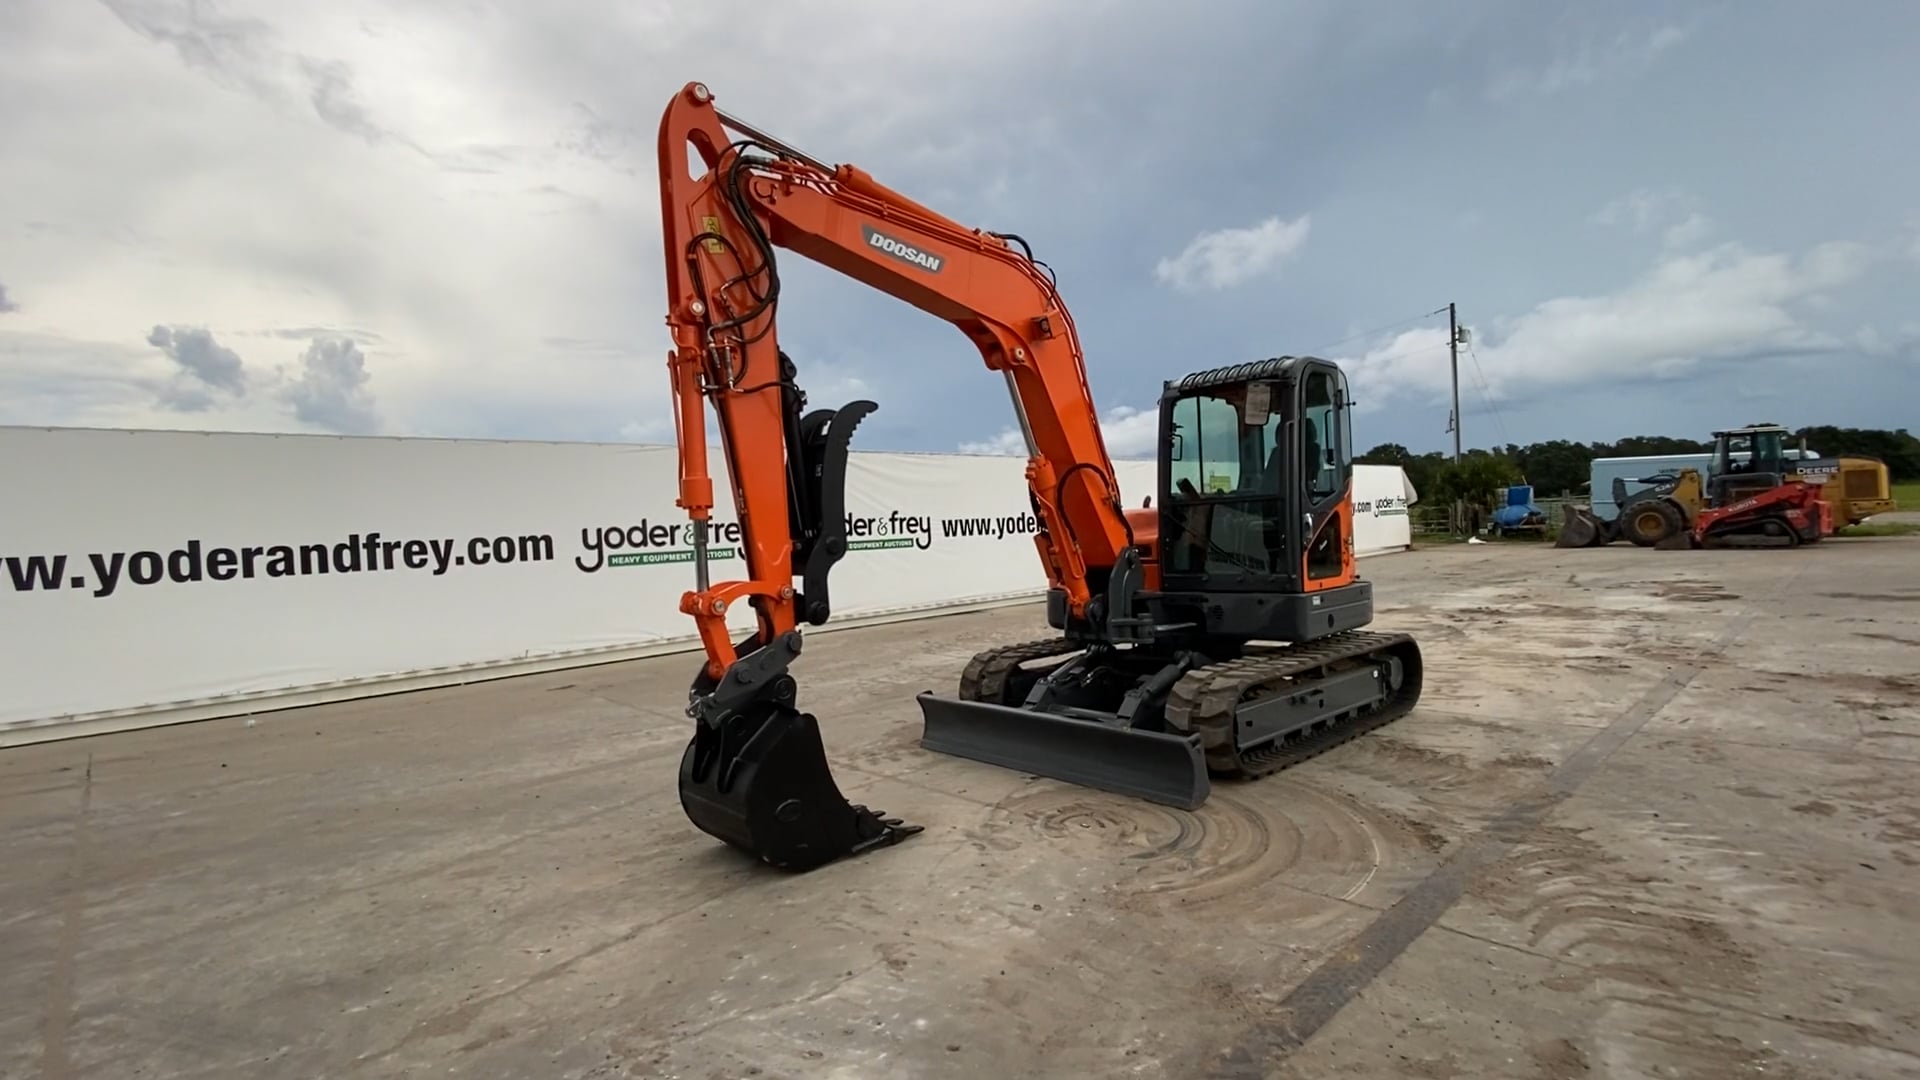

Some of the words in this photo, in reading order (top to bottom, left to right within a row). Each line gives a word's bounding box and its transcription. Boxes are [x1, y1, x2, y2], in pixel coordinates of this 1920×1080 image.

[870, 233, 939, 271] DOOSAN
[1797, 467, 1838, 475] DEERE
[942, 512, 1040, 540] www.yode
[0, 532, 554, 598] w.yoderandfrey.com
[612, 555, 641, 564] HEAVY
[643, 552, 692, 562] EQUIPMENT
[707, 550, 733, 559] TIONS
